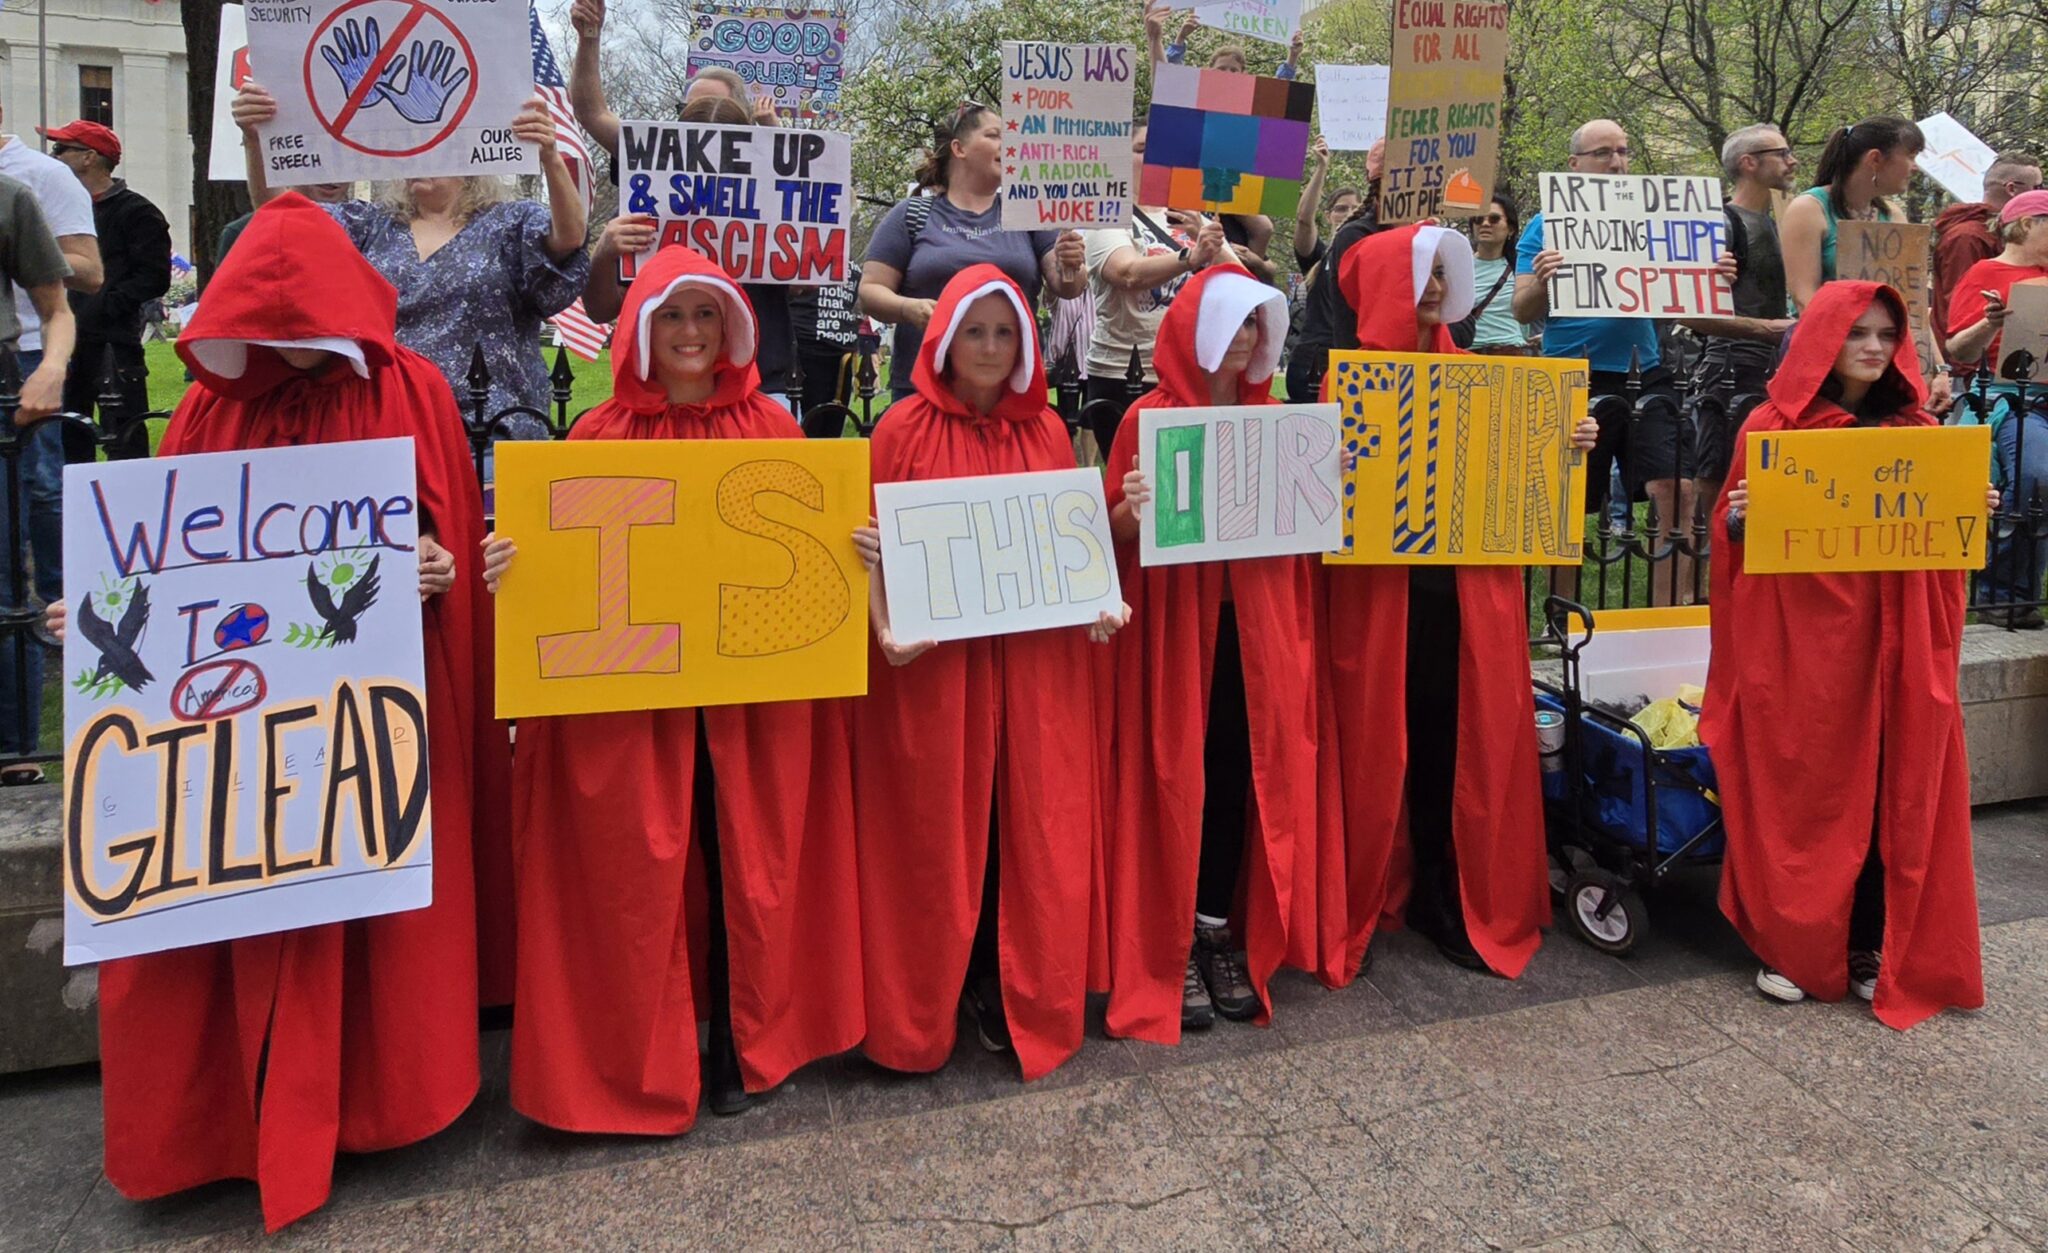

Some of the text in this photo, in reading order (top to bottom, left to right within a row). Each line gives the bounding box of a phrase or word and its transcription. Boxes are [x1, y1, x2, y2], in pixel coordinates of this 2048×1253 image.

[249, 6, 312, 24] SECURITY
[1223, 11, 1289, 38] SPOKEN
[1398, 0, 1507, 30] EQUAL RIGHTS
[713, 19, 831, 56] GOOD
[1413, 32, 1481, 64] FOR ALL
[688, 56, 841, 90] TOUBLE
[1009, 43, 1129, 82] JESUS WAS
[1027, 87, 1073, 109] POOR
[1021, 114, 1131, 137] AN IMMIGRANT
[1447, 102, 1496, 131] RIGHTS
[269, 134, 304, 150] FREE
[481, 129, 512, 144] OUR
[623, 126, 826, 178] WAKE UP
[1020, 143, 1098, 161] ANTI-RICH
[1409, 132, 1477, 166] FOR YOU
[271, 154, 321, 170] SPEECH
[470, 147, 523, 164] ALLIES
[1020, 163, 1113, 181] A RADICAL
[1388, 165, 1444, 192] IT IS
[628, 173, 842, 224] & SMELL THE
[1008, 181, 1127, 200] AND YOU CALL ME
[1382, 188, 1444, 221] NOT PIE.
[1549, 176, 1610, 213] ART
[1615, 192, 1634, 201] THE
[1642, 178, 1722, 213] DEAL
[1544, 217, 1726, 263] TRADING HOPE
[1861, 228, 1902, 263] NO
[817, 297, 844, 309] that
[819, 286, 854, 302] notion
[1553, 263, 1733, 315] FOR SPITE
[816, 319, 840, 330] are
[817, 308, 857, 321] wome
[1332, 362, 1586, 558] FUTURE
[1761, 438, 1914, 508] Hands off
[1155, 413, 1339, 548] OUR
[90, 462, 416, 578] Welcome
[1875, 492, 1928, 519] MY
[536, 459, 850, 679] IS
[895, 489, 1111, 620] THIS
[68, 681, 430, 916] GILEAD
